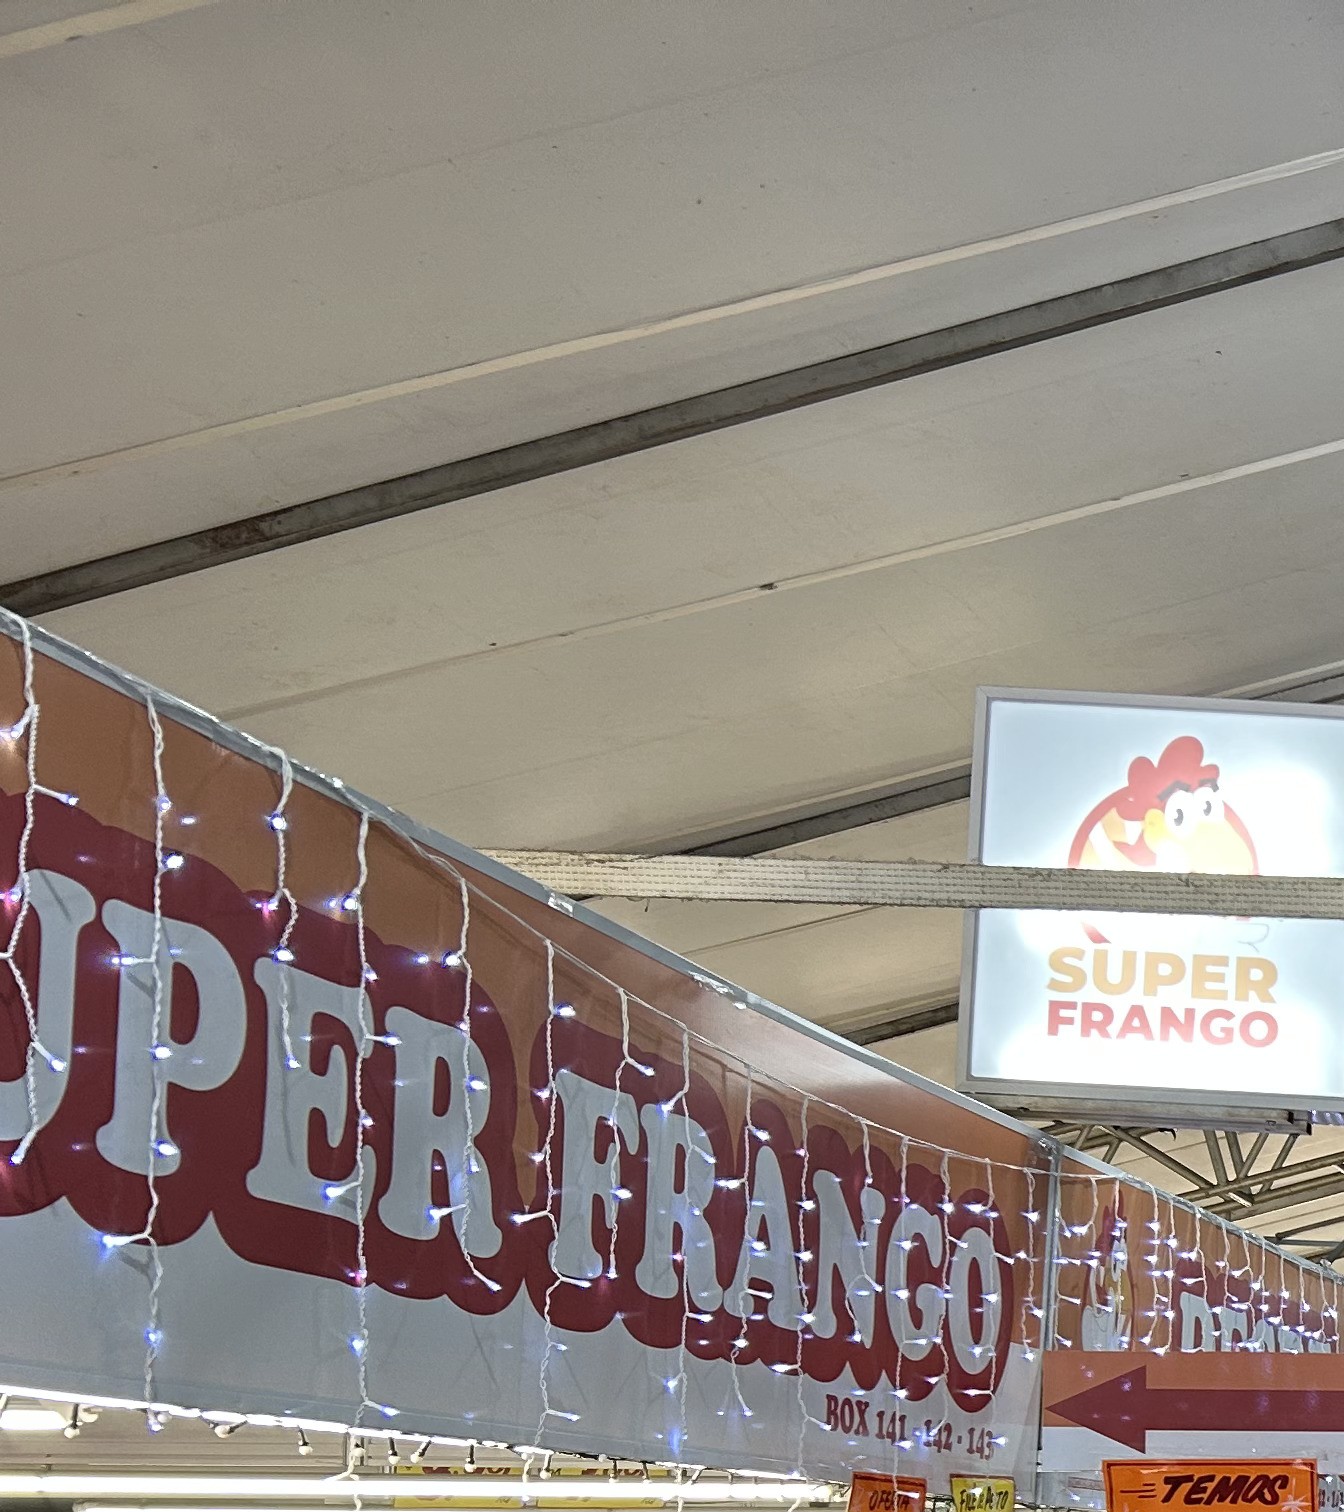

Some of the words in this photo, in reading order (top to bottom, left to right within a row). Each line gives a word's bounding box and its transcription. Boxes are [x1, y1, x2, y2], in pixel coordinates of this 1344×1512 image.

[1046, 946, 1279, 1004] SUPER
[1047, 1000, 1279, 1049] FRANGO
[548, 1070, 1001, 1375] FRANGO
[826, 1394, 869, 1437] BOX
[875, 1410, 908, 1446] 141
[967, 1427, 995, 1461] 143
[1160, 1474, 1290, 1506] TEMOS
